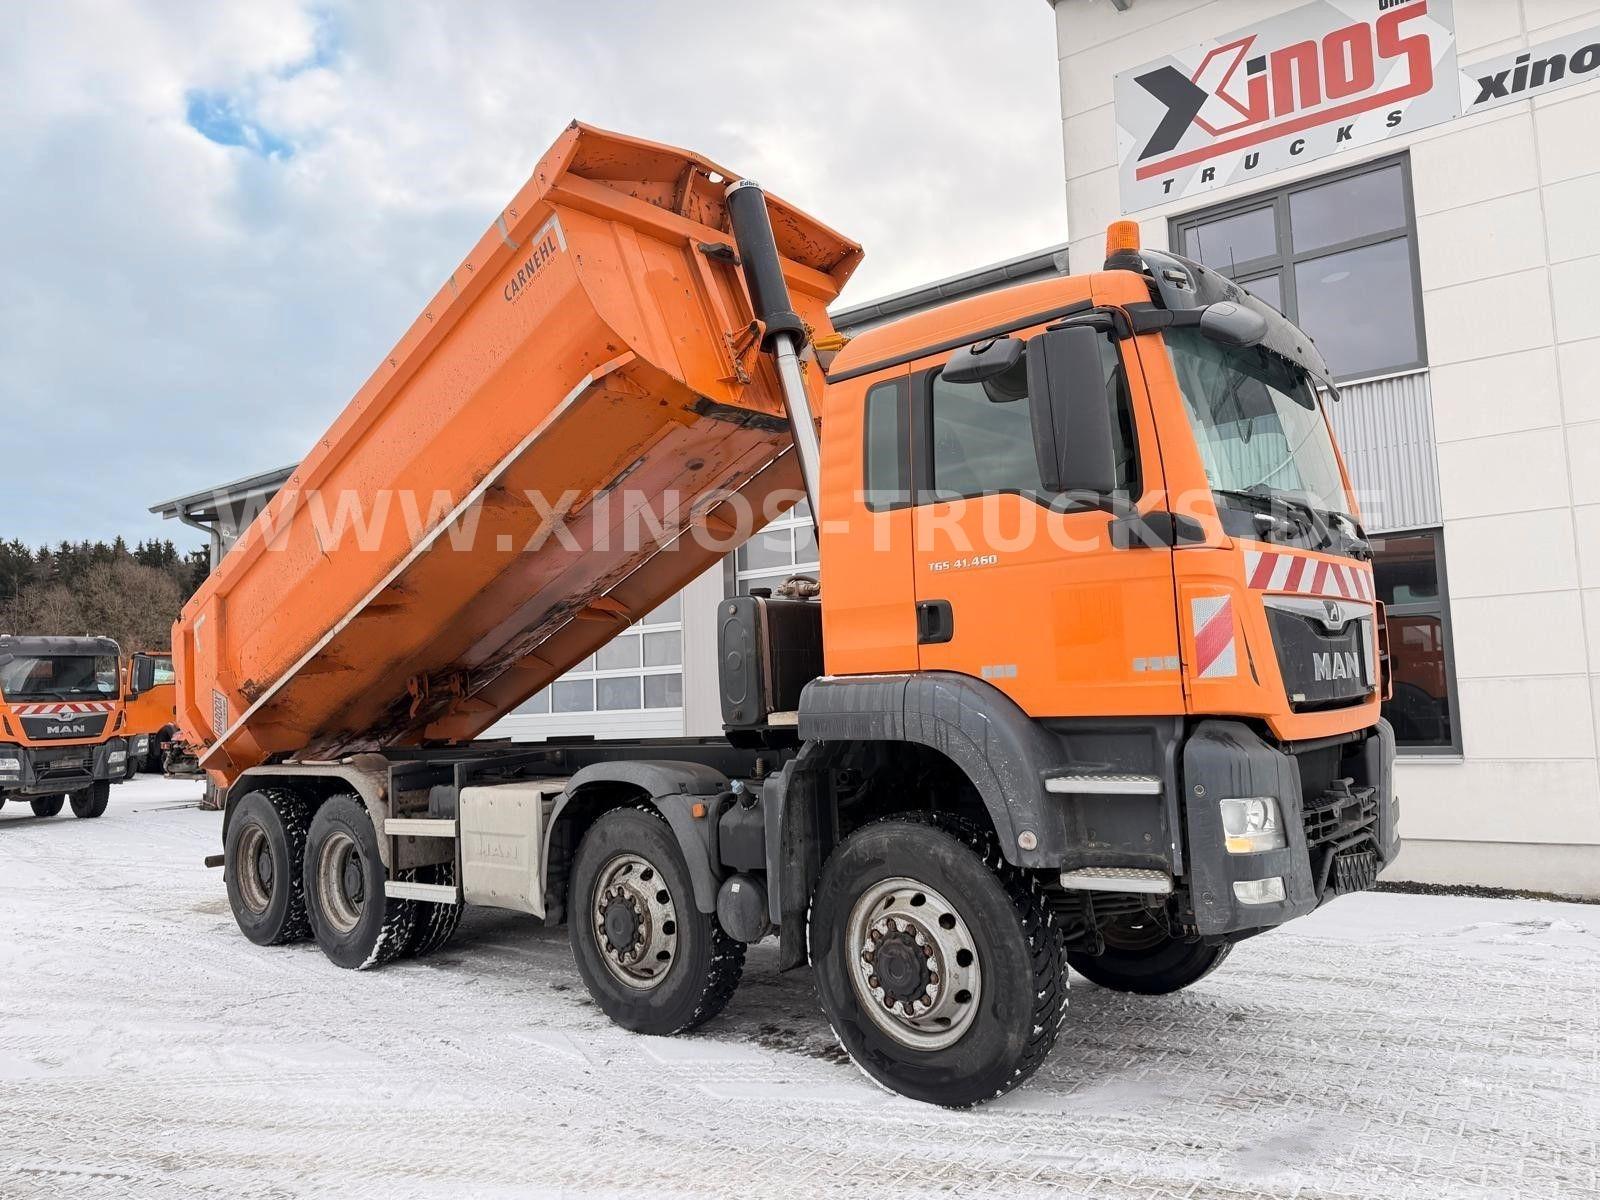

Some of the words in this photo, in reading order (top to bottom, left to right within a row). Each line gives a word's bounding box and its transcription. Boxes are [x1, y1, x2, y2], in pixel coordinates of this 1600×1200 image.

[1162, 110, 1402, 194] TRUCKS
[504, 236, 556, 301] CARNEHL
[928, 561, 950, 572] TGS
[953, 554, 998, 569] 41.460
[1312, 652, 1360, 681] MAN
[46, 724, 85, 734] MAN
